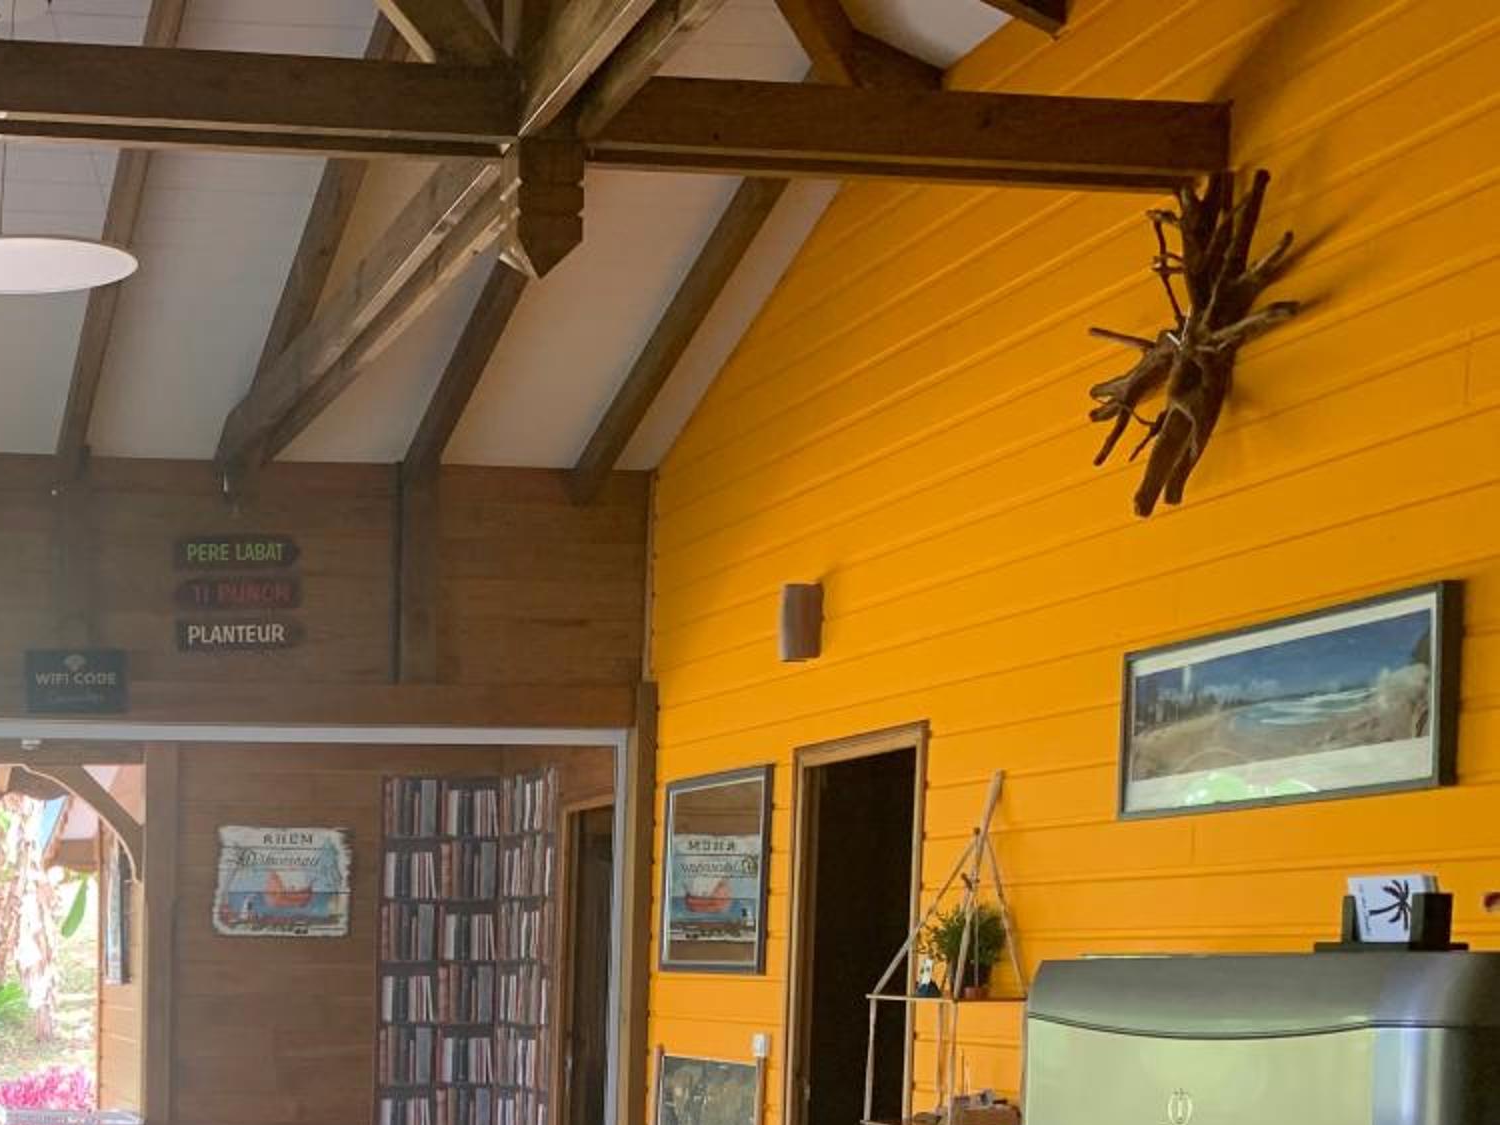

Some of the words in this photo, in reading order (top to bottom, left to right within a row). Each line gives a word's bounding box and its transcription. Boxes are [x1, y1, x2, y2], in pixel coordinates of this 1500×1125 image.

[187, 543, 228, 561] PERE
[236, 543, 284, 561] LABAT
[187, 623, 285, 644] PLANTEUR
[73, 671, 117, 685] CODE
